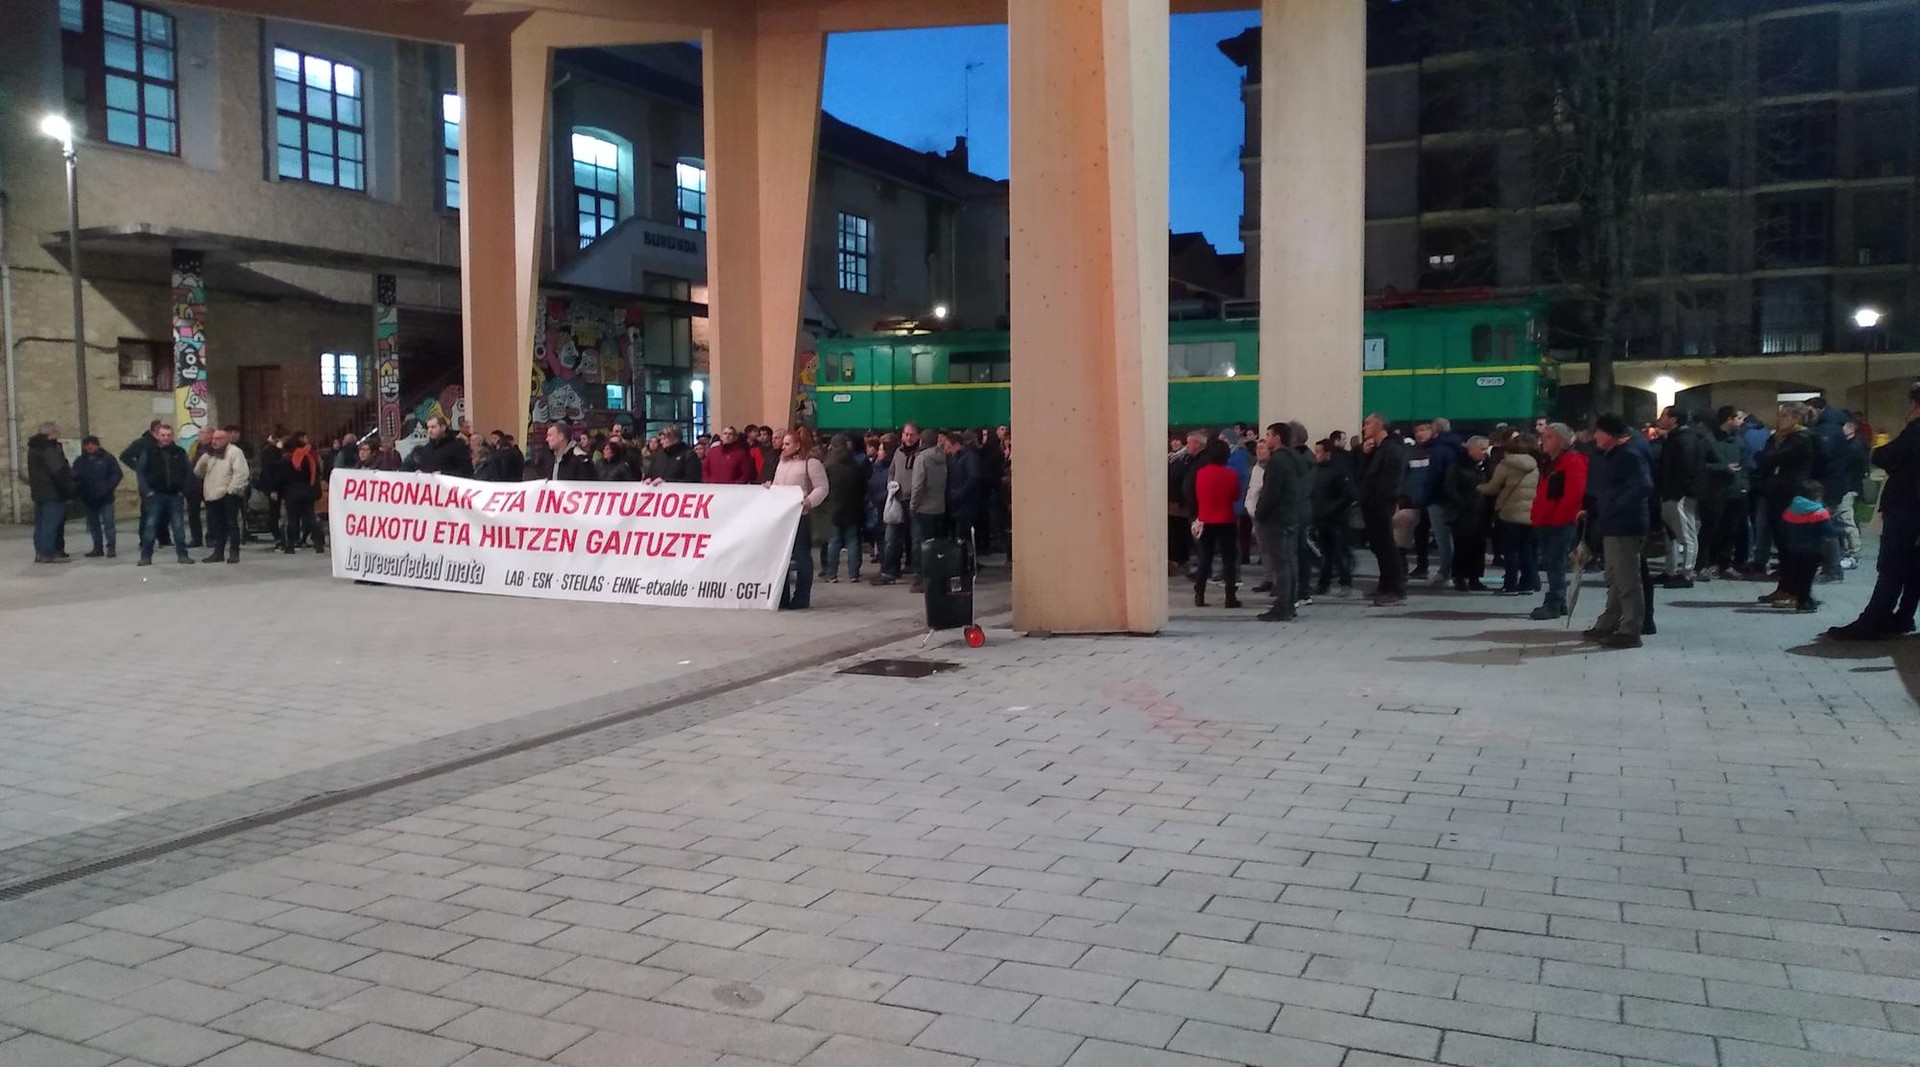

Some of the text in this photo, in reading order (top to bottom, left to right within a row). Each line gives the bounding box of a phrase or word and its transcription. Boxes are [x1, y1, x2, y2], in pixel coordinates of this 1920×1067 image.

[643, 230, 698, 255] BURUNDA
[343, 478, 714, 519] PATRONALAK ETA INSTITUZIOEK
[345, 513, 711, 559] GAIXOTU ETA HILTZEN GAITUZTE
[344, 547, 486, 585] La precariedad mata
[504, 569, 525, 587] LAB
[532, 571, 553, 589] ESK
[560, 573, 606, 593] STEILAS
[612, 576, 688, 598] EHNE-etxalde
[698, 581, 727, 600] HIRU
